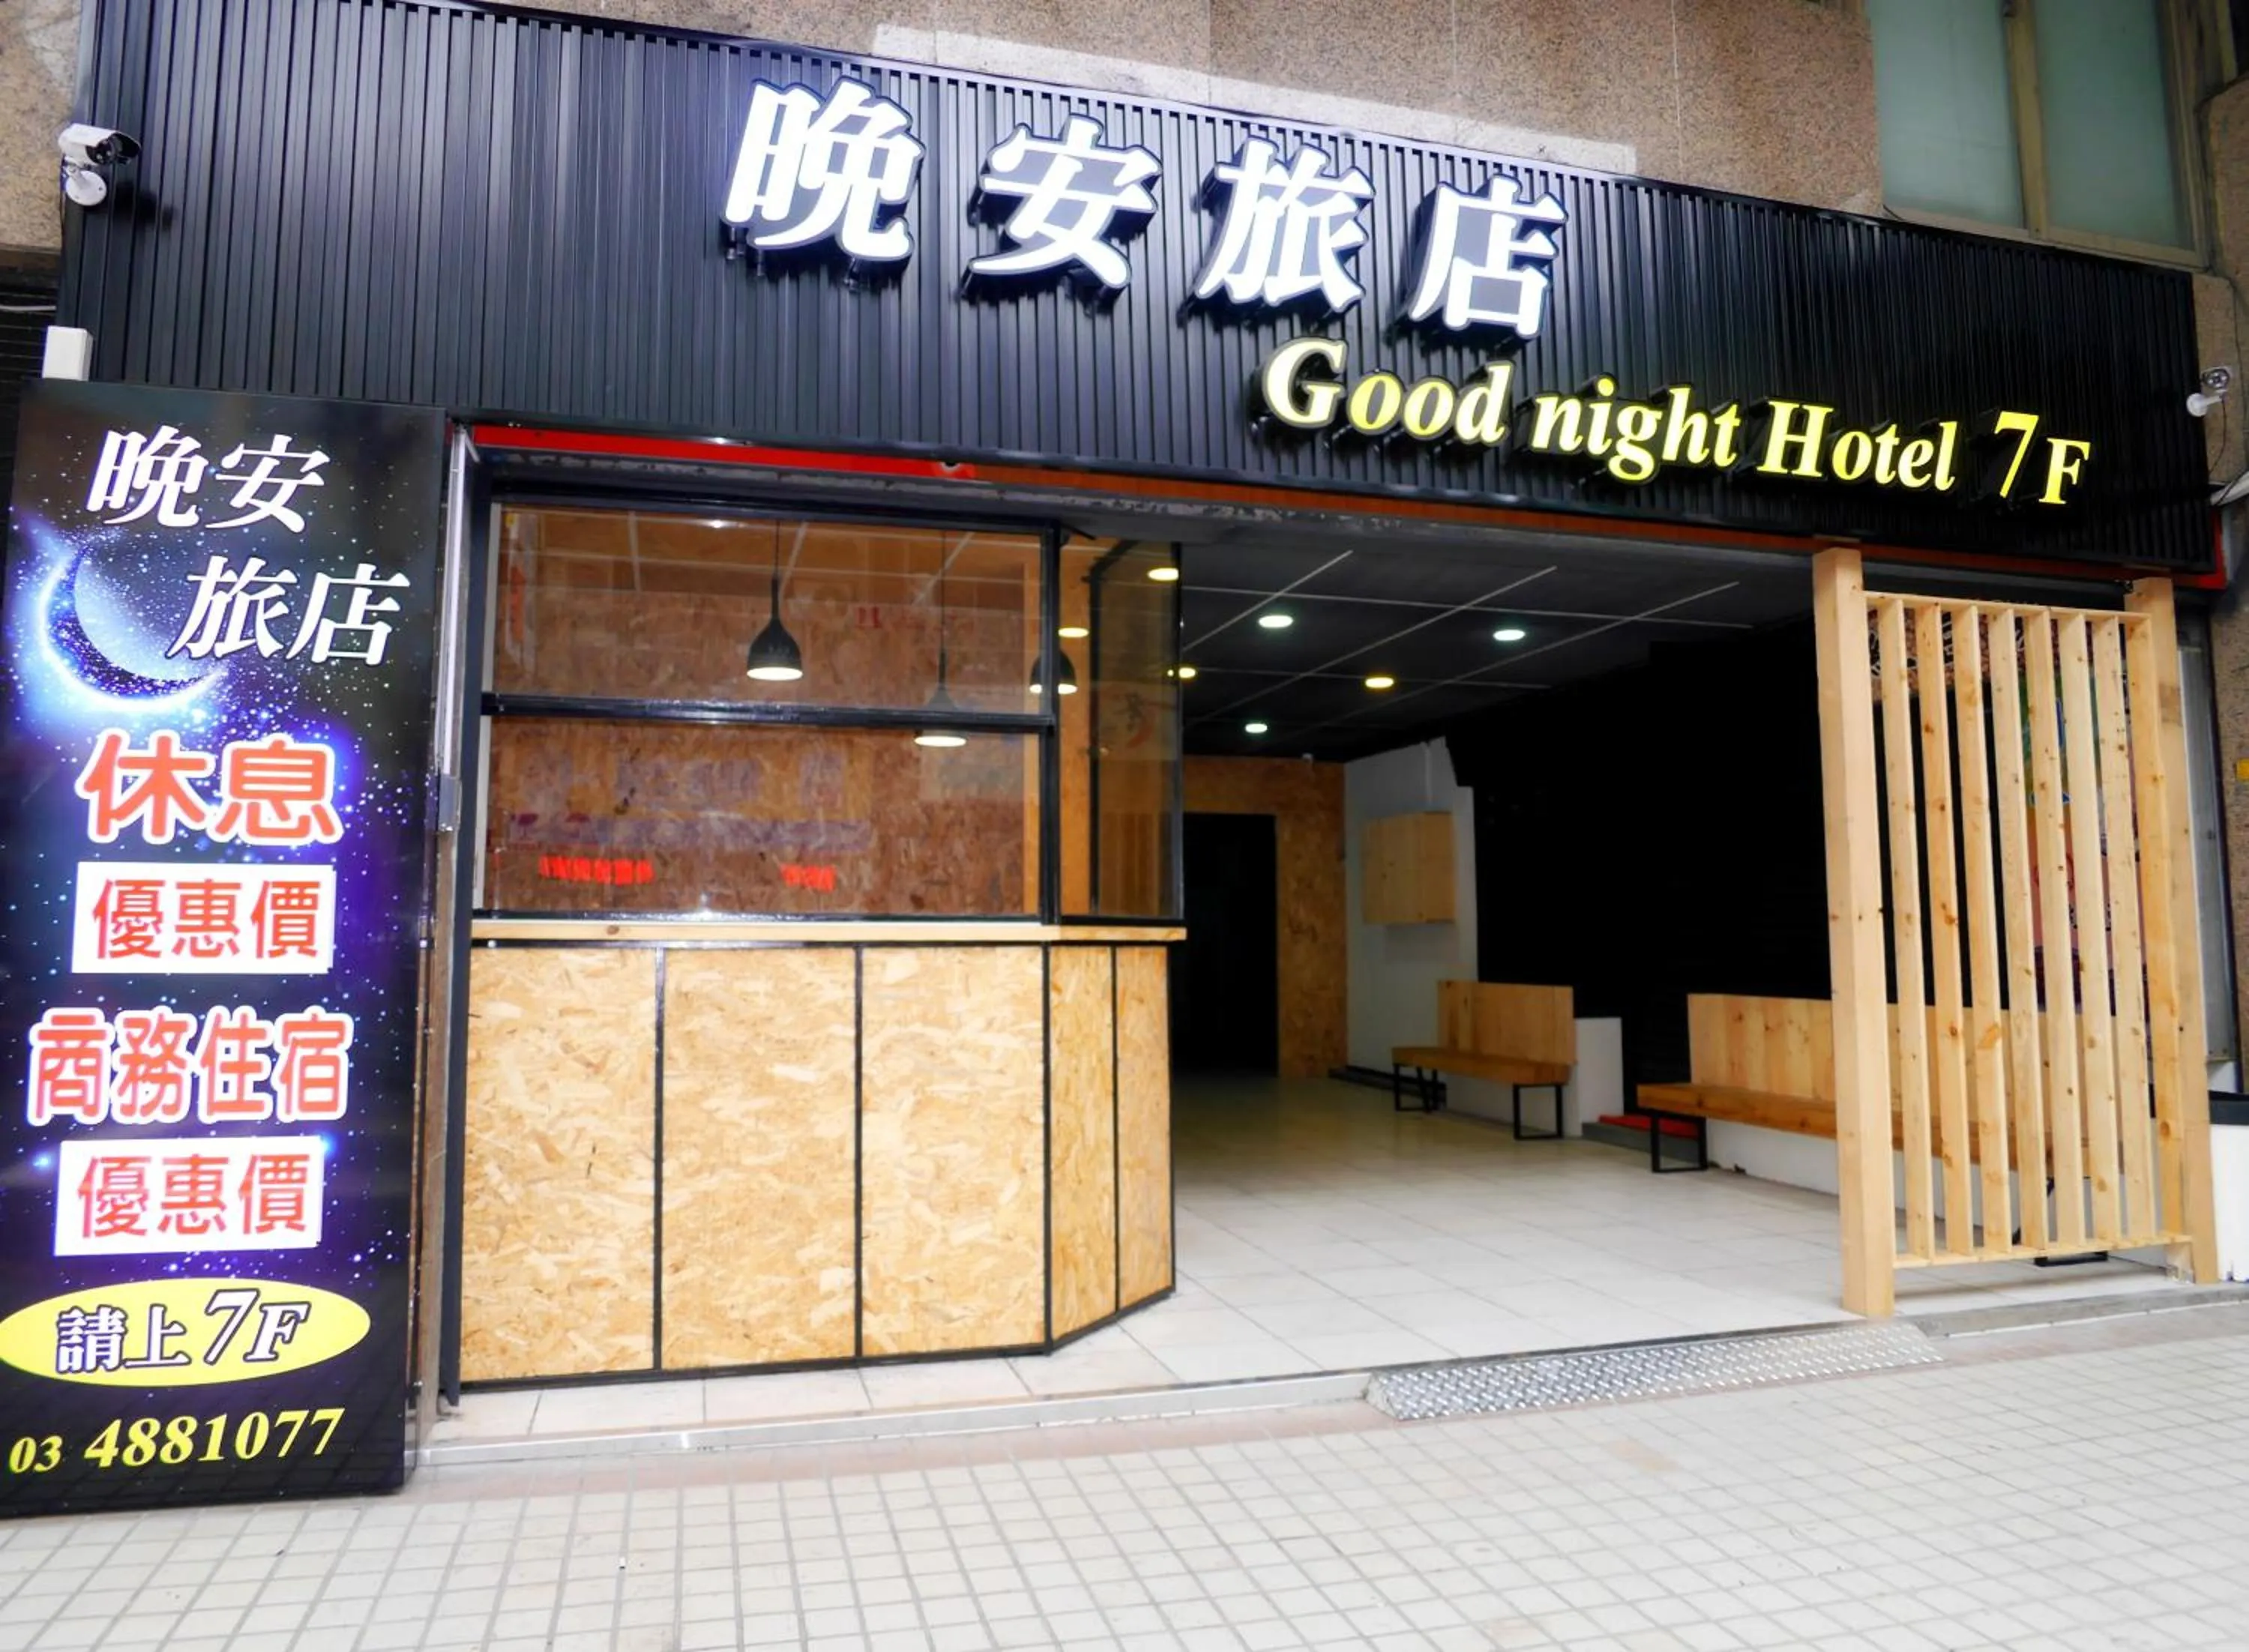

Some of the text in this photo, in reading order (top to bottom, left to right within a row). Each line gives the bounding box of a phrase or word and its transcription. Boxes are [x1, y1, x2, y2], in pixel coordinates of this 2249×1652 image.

[724, 76, 1568, 340] 晚安旅店
[1262, 337, 2092, 506] Good night Hotel 7F
[86, 425, 330, 533] 晚安
[166, 556, 410, 665] 旅店
[76, 729, 344, 845] 休息
[91, 878, 322, 959] 優惠價
[28, 1007, 354, 1124] 商務住宿
[76, 1154, 310, 1239] 優惠價
[10, 1408, 345, 1474] 03 4881077
